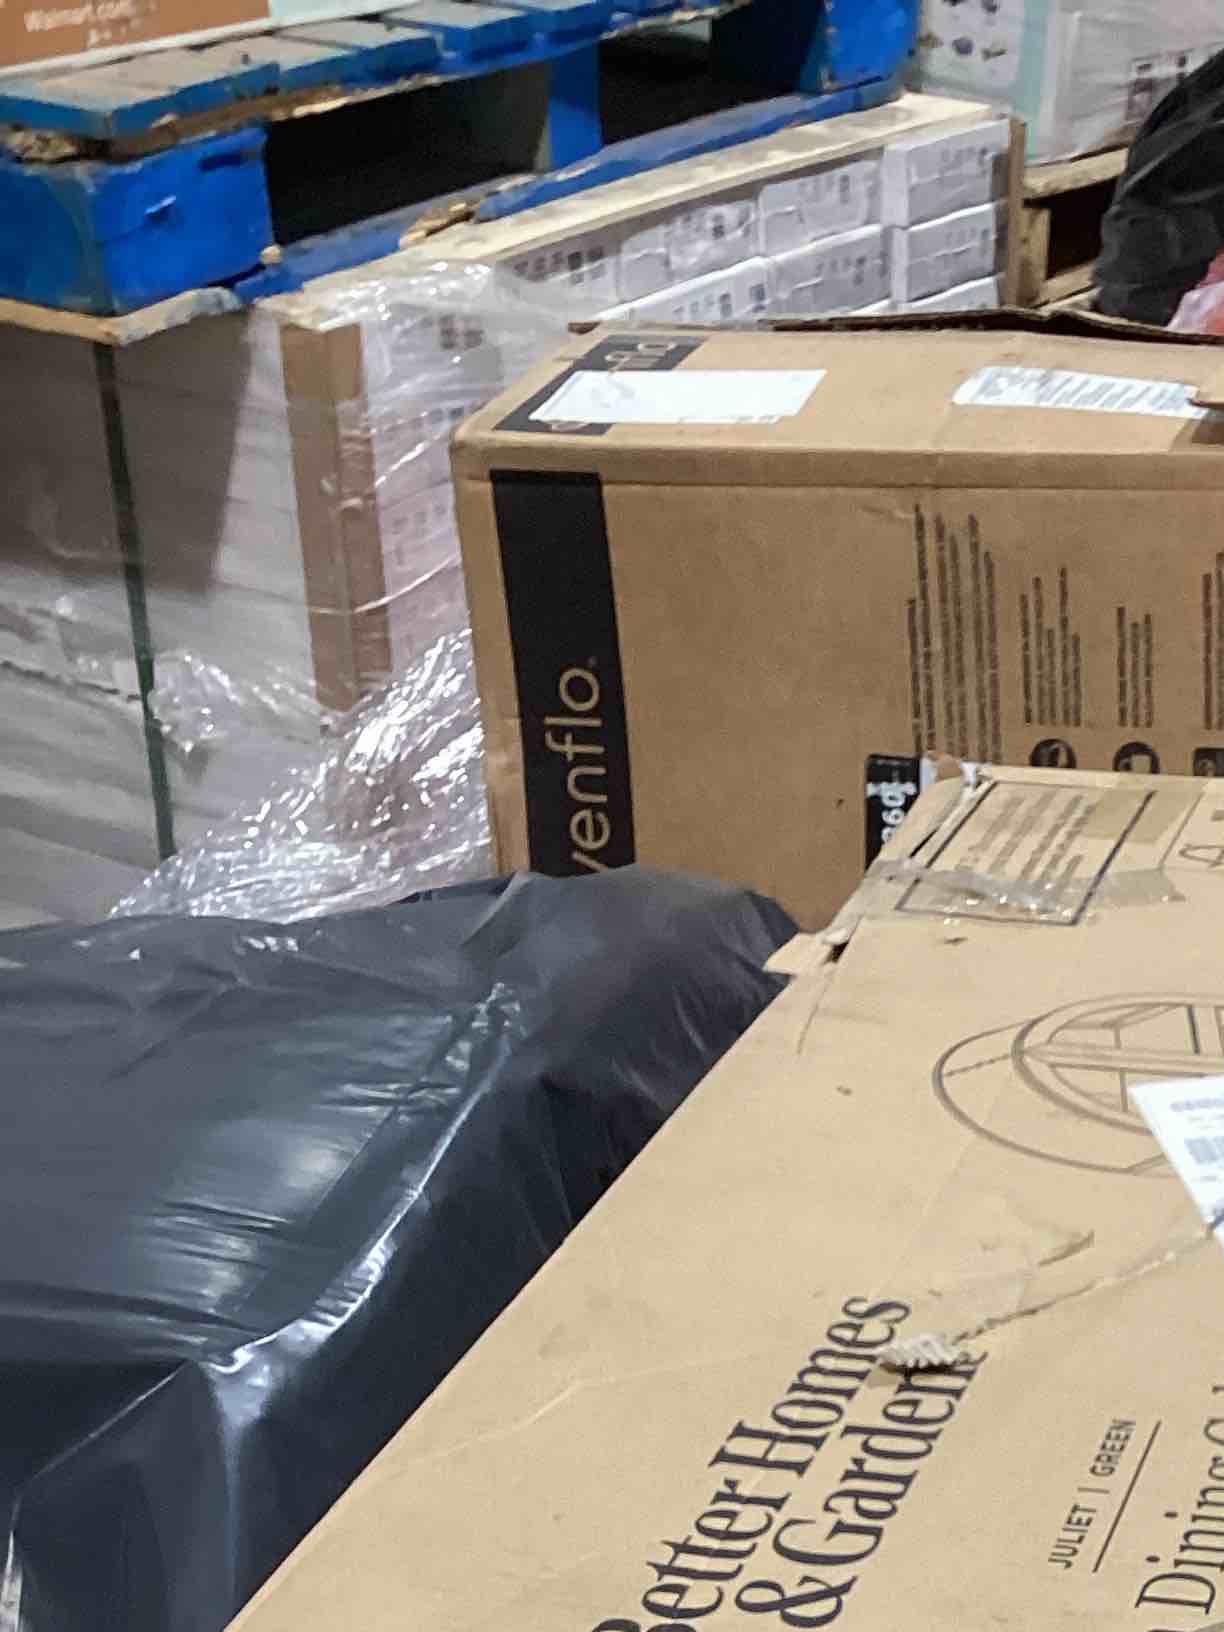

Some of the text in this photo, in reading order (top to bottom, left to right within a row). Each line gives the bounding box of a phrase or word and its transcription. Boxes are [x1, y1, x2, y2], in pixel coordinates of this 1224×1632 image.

[709, 1296, 911, 1477] Homes
[1048, 1504, 1097, 1568] JULIET
[1090, 1418, 1136, 1477] GREEN
